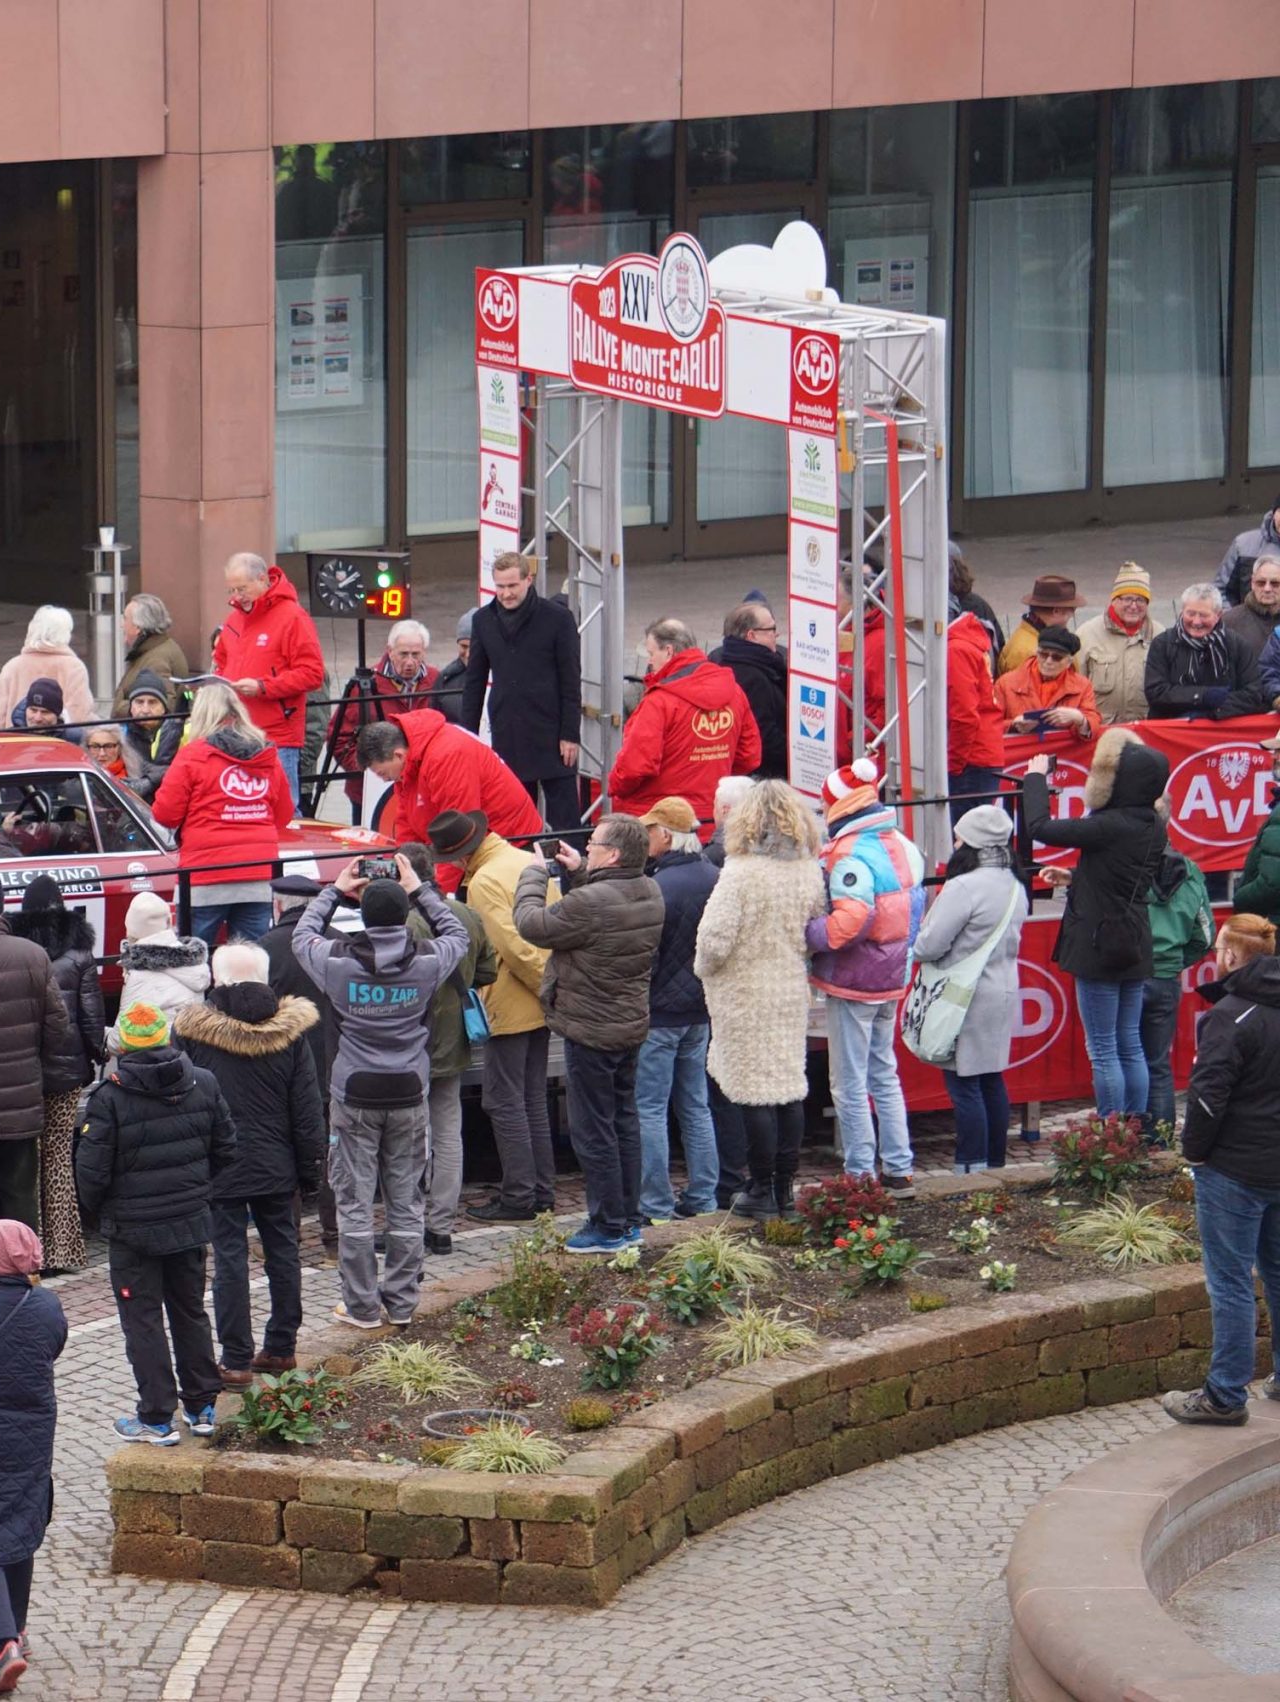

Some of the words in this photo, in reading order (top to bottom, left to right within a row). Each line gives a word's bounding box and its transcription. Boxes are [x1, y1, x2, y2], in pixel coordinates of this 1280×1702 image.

[622, 270, 650, 323] XXV
[573, 301, 618, 371] RALLYE
[621, 332, 720, 392] MONTE-CARLO
[608, 372, 682, 402] HISTORIQUE
[801, 705, 825, 721] BOSCH
[0, 864, 19, 886] LE
[348, 982, 386, 1004] ISO
